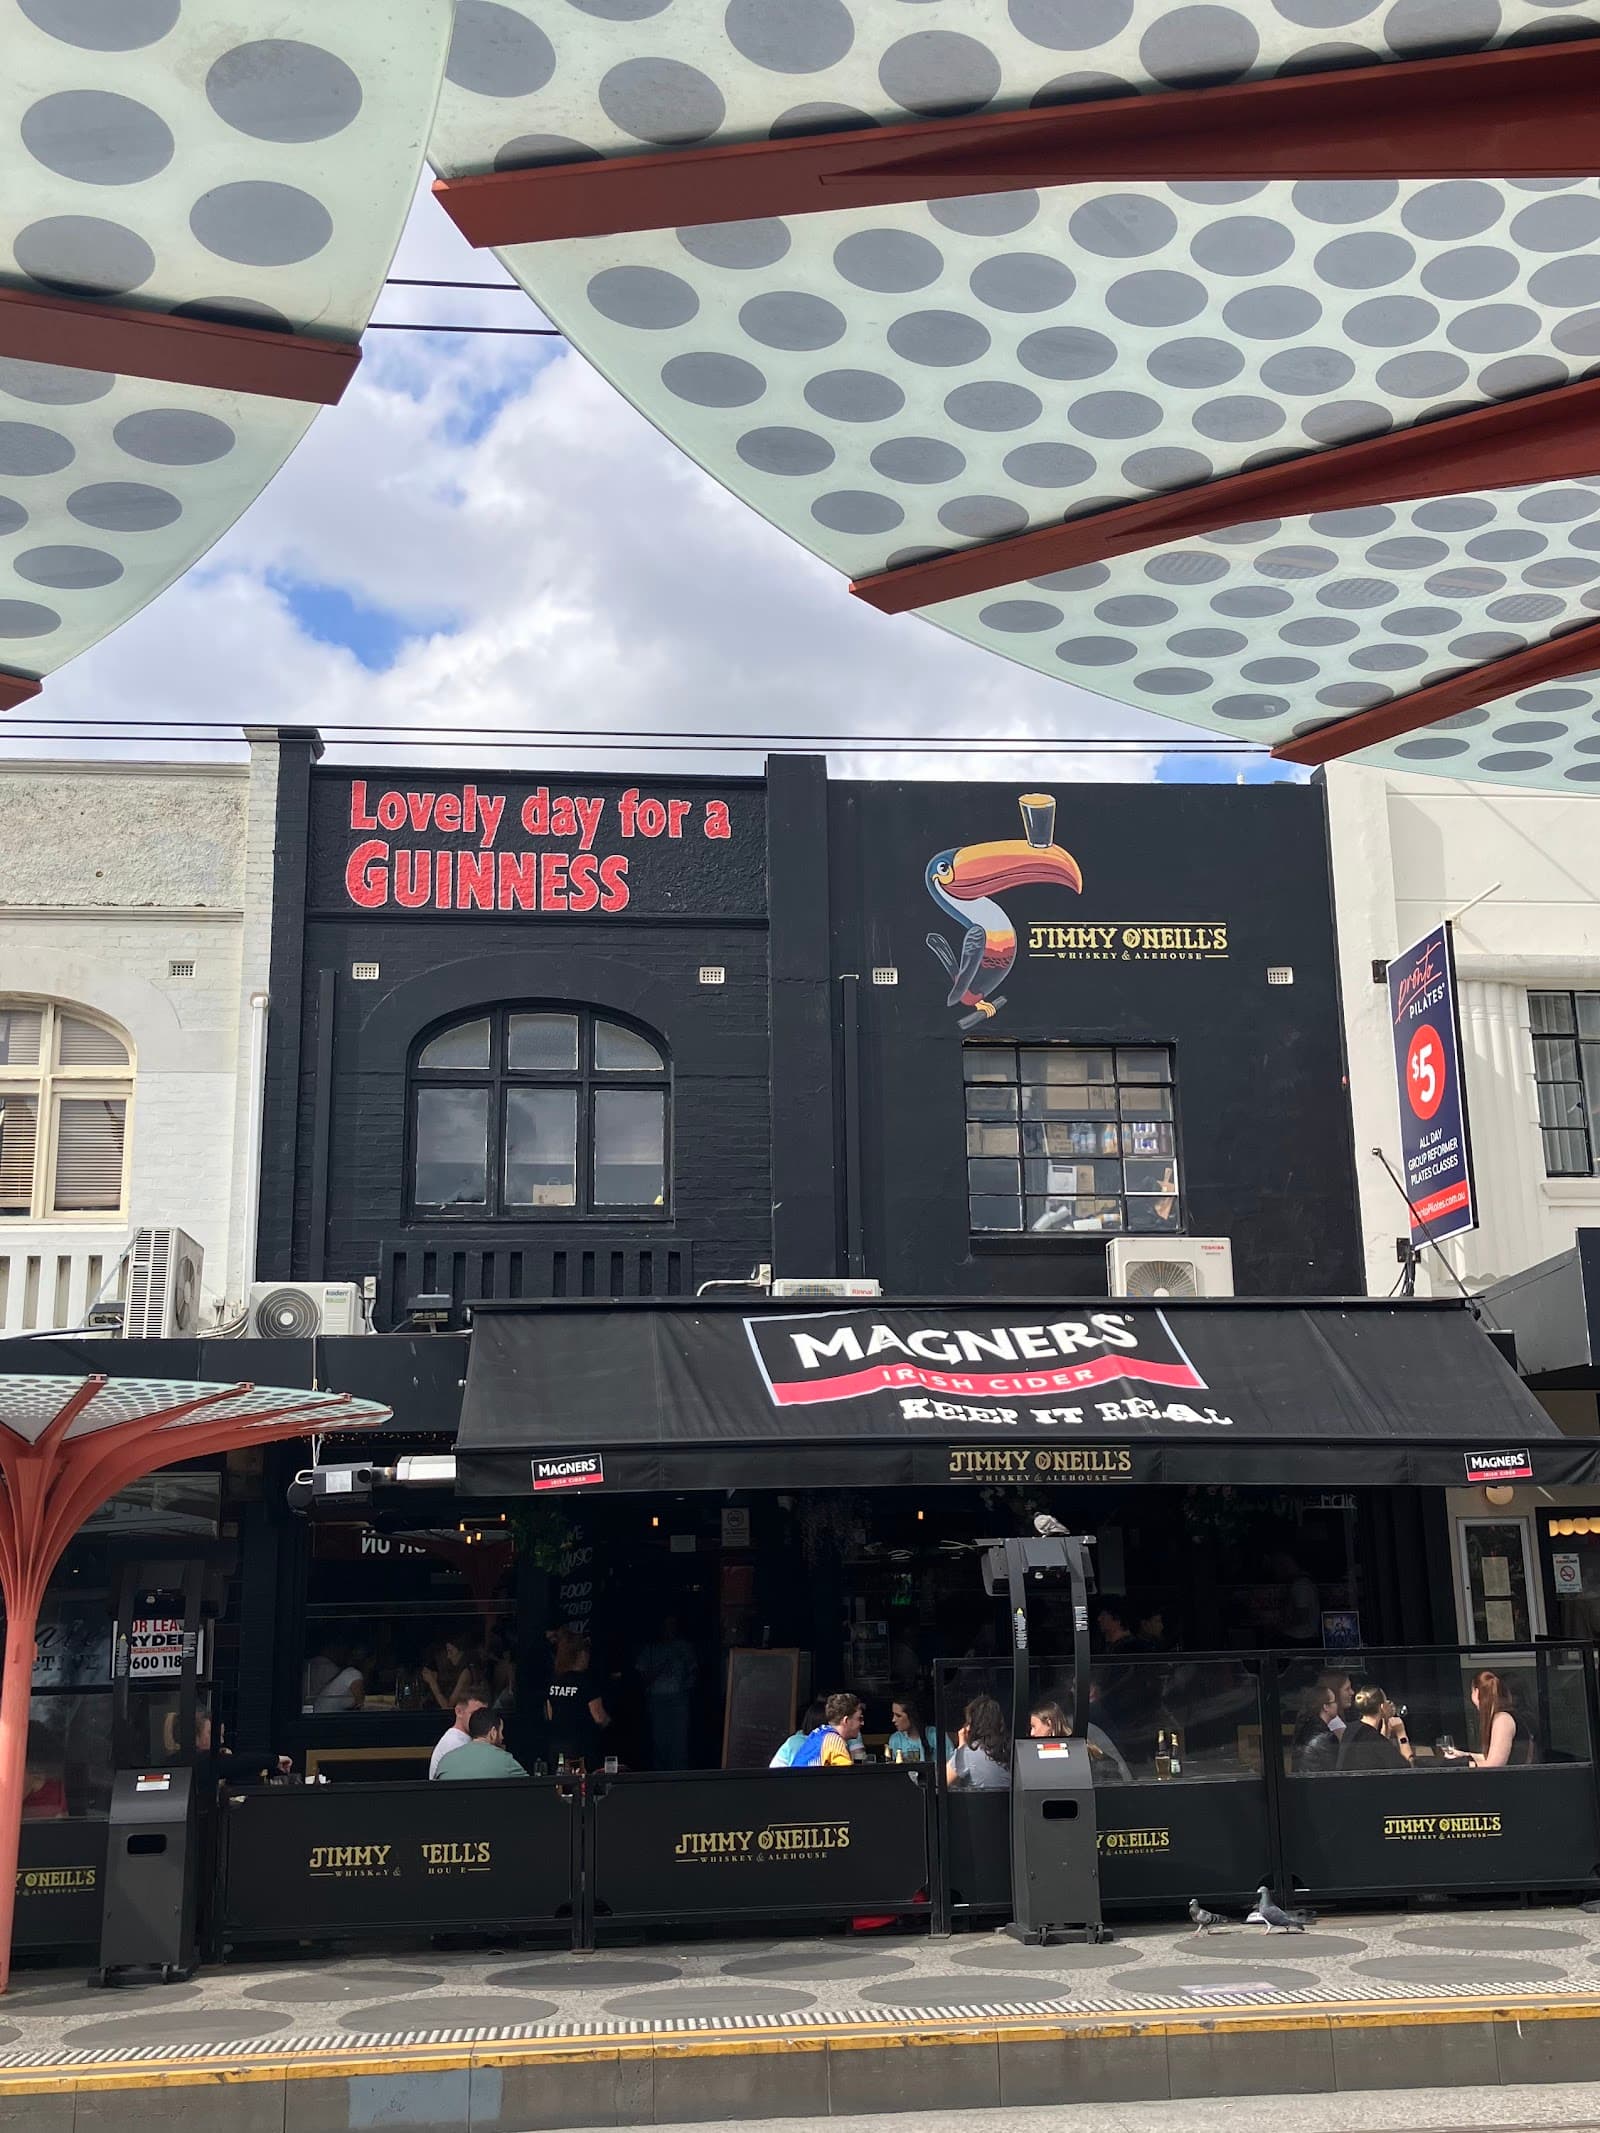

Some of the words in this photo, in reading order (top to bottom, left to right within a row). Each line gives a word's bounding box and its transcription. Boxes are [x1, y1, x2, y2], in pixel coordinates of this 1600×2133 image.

[350, 780, 505, 848] Lovely
[522, 787, 604, 850] day
[618, 788, 691, 838] for
[704, 800, 731, 839] a
[345, 839, 630, 912] GUINNESS
[1029, 927, 1118, 949] JIMMY
[1122, 927, 1228, 949] O'NEILL'S
[1057, 952, 1117, 960] WHISKEY
[1121, 950, 1131, 960] &
[1134, 952, 1202, 960] ALEHOUSE
[1409, 984, 1444, 1019] PILATES
[1411, 1044, 1436, 1103] $5
[1419, 1135, 1430, 1150] ALL
[1430, 1128, 1442, 1144] DAY
[1408, 1153, 1427, 1171] GROUP
[1427, 1137, 1458, 1162] REFORMER
[1411, 1166, 1432, 1186] PILATES
[1431, 1154, 1459, 1176] CLASSES
[789, 1313, 1138, 1368] MAGNERS
[883, 1368, 972, 1391] IRISH
[989, 1368, 1096, 1391] CIDER
[899, 1398, 1018, 1426] KEEP
[1031, 1407, 1084, 1425] IT
[1101, 1397, 1234, 1426] REAL
[538, 1458, 597, 1477] MAGNERS
[950, 1450, 1031, 1472] JIMMY
[1034, 1450, 1132, 1472] O'NEILL'S
[1471, 1453, 1525, 1469] MAGNERS
[1034, 1473, 1042, 1482] &
[549, 1685, 578, 1697] STAFF
[1384, 1818, 1436, 1834] JIMMY
[1439, 1816, 1501, 1832] O'NEILL'S
[675, 1831, 753, 1854] JIMMY
[757, 1827, 850, 1850] O'NEILL'S
[309, 1845, 391, 1868] JIMMY
[700, 1854, 752, 1863] WHISKEY
[756, 1853, 765, 1863] &
[768, 1851, 827, 1860] ALEHOUSE
[25, 1870, 96, 1887] O'NEILL'S
